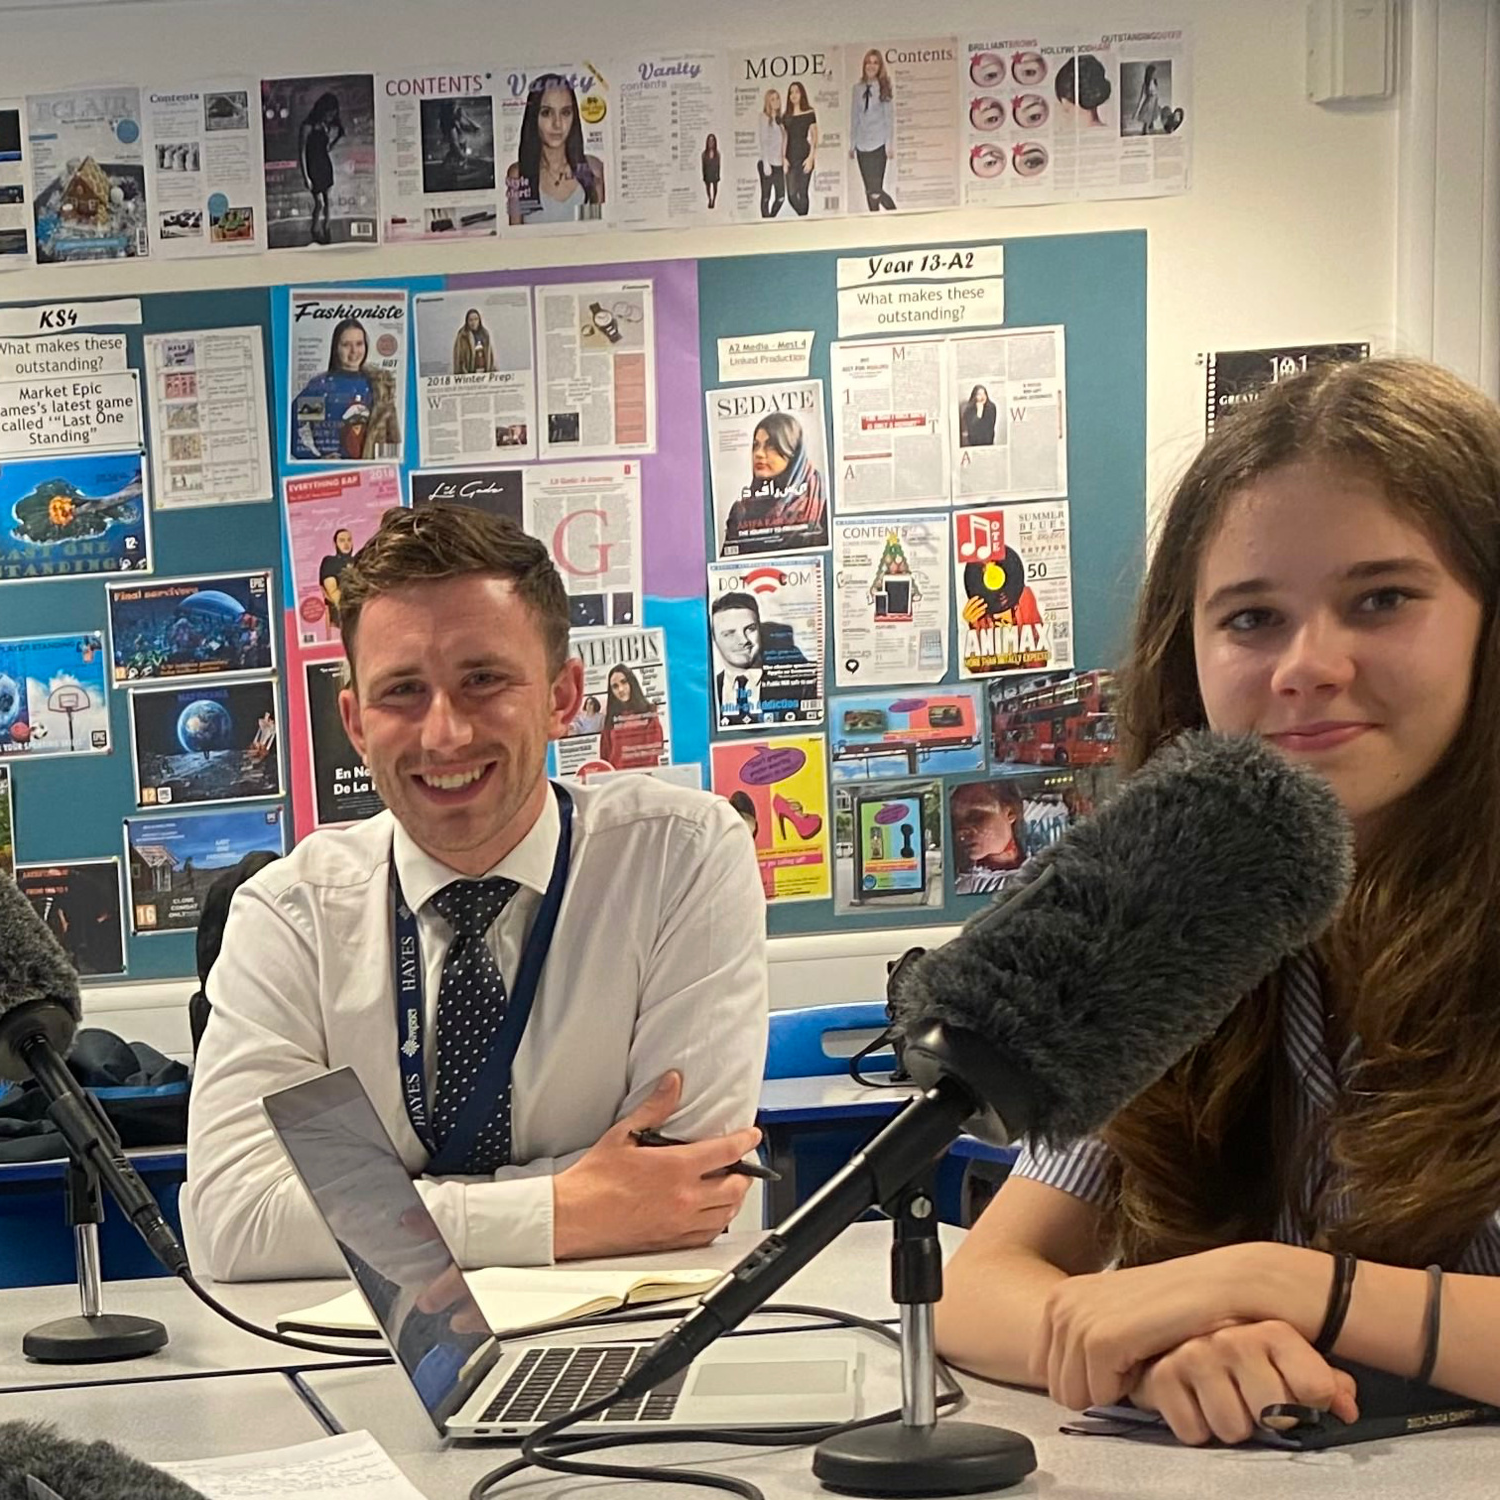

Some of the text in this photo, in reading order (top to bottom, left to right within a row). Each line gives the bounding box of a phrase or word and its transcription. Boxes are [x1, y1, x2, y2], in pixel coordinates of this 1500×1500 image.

[885, 48, 953, 65] Contents
[638, 62, 702, 81] Vanity
[385, 75, 483, 97] CONTENTS
[150, 92, 200, 104] Contents
[867, 251, 975, 280] Year 13-A2
[857, 286, 985, 306] What makes these
[39, 310, 78, 329] KS4
[294, 302, 404, 323] Fashioniste
[877, 305, 966, 325] outstanding?
[35, 340, 80, 353] makes
[84, 336, 123, 350] these
[743, 341, 769, 351] Media
[16, 356, 104, 375] outstanding?
[427, 371, 515, 386] 2018 Winter Prep:
[19, 382, 102, 400] Market Epic
[52, 399, 92, 413] latest
[96, 397, 134, 415] game
[717, 390, 814, 417] SEDATE
[1, 416, 43, 432] called
[96, 410, 124, 424] One
[289, 478, 340, 493] EVERYTHING
[1019, 511, 1065, 521] SUMMER
[842, 526, 908, 539] CONTENTS
[553, 509, 615, 578] G
[1027, 562, 1047, 579] 50
[964, 623, 1050, 657] ANIMAX
[335, 768, 351, 780] En
[334, 781, 368, 795] De La
[139, 906, 156, 924] 16
[401, 936, 417, 992] HAYES
[406, 1072, 426, 1126] HAYES
